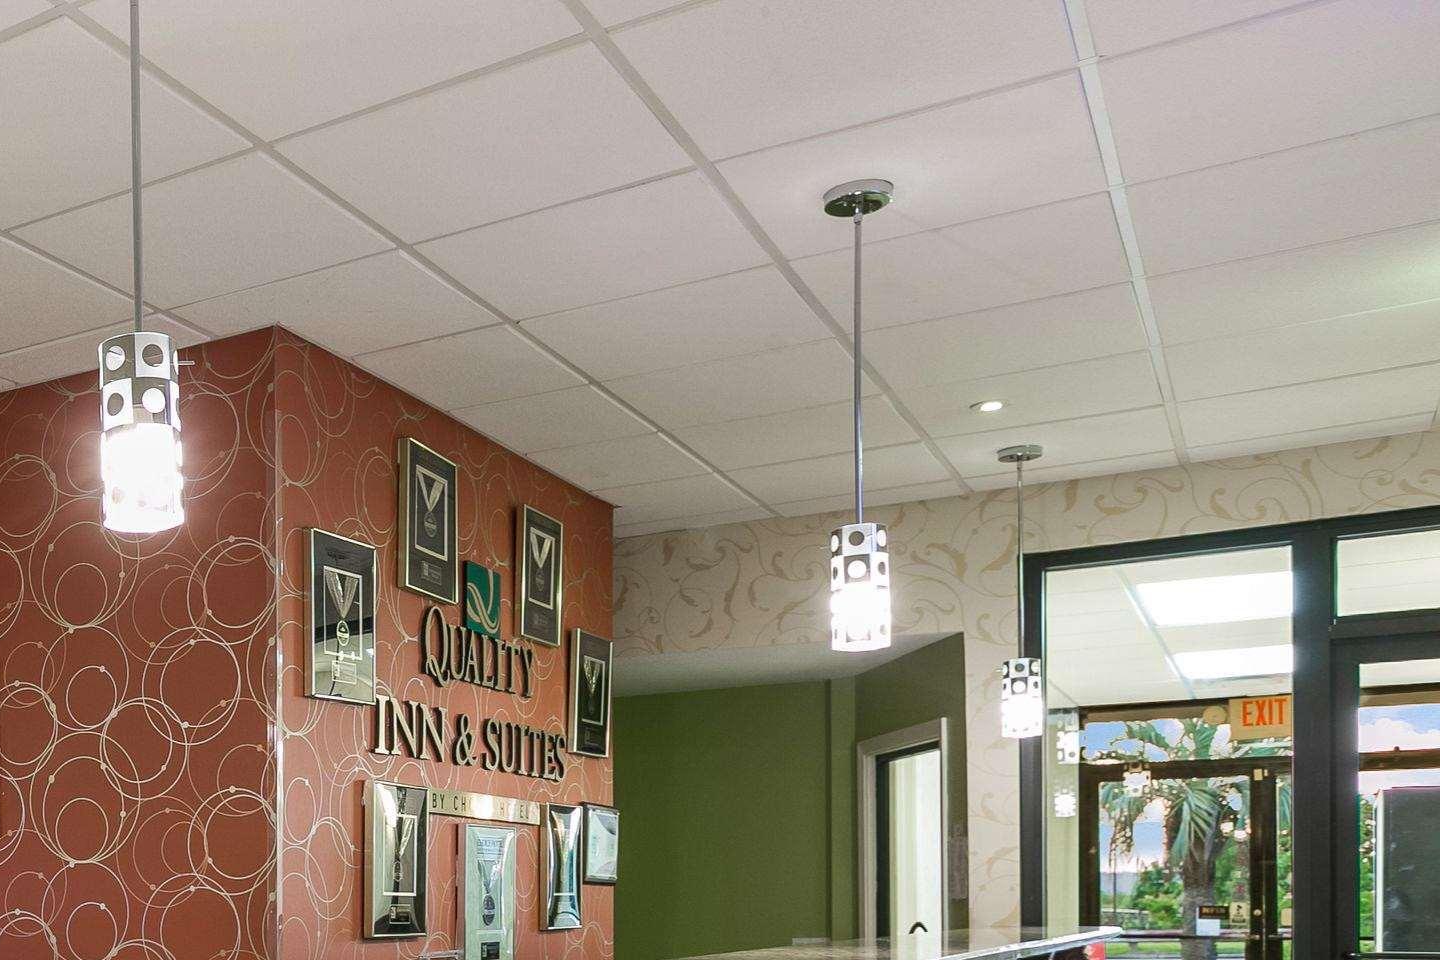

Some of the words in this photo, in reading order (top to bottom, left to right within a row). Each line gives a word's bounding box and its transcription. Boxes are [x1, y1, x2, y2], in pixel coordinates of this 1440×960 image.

[423, 606, 534, 699] QUALITY
[375, 694, 447, 763] INN
[453, 714, 477, 767] &
[482, 718, 567, 783] SUITES
[1242, 698, 1287, 726] EXIT
[432, 793, 445, 810] BY
